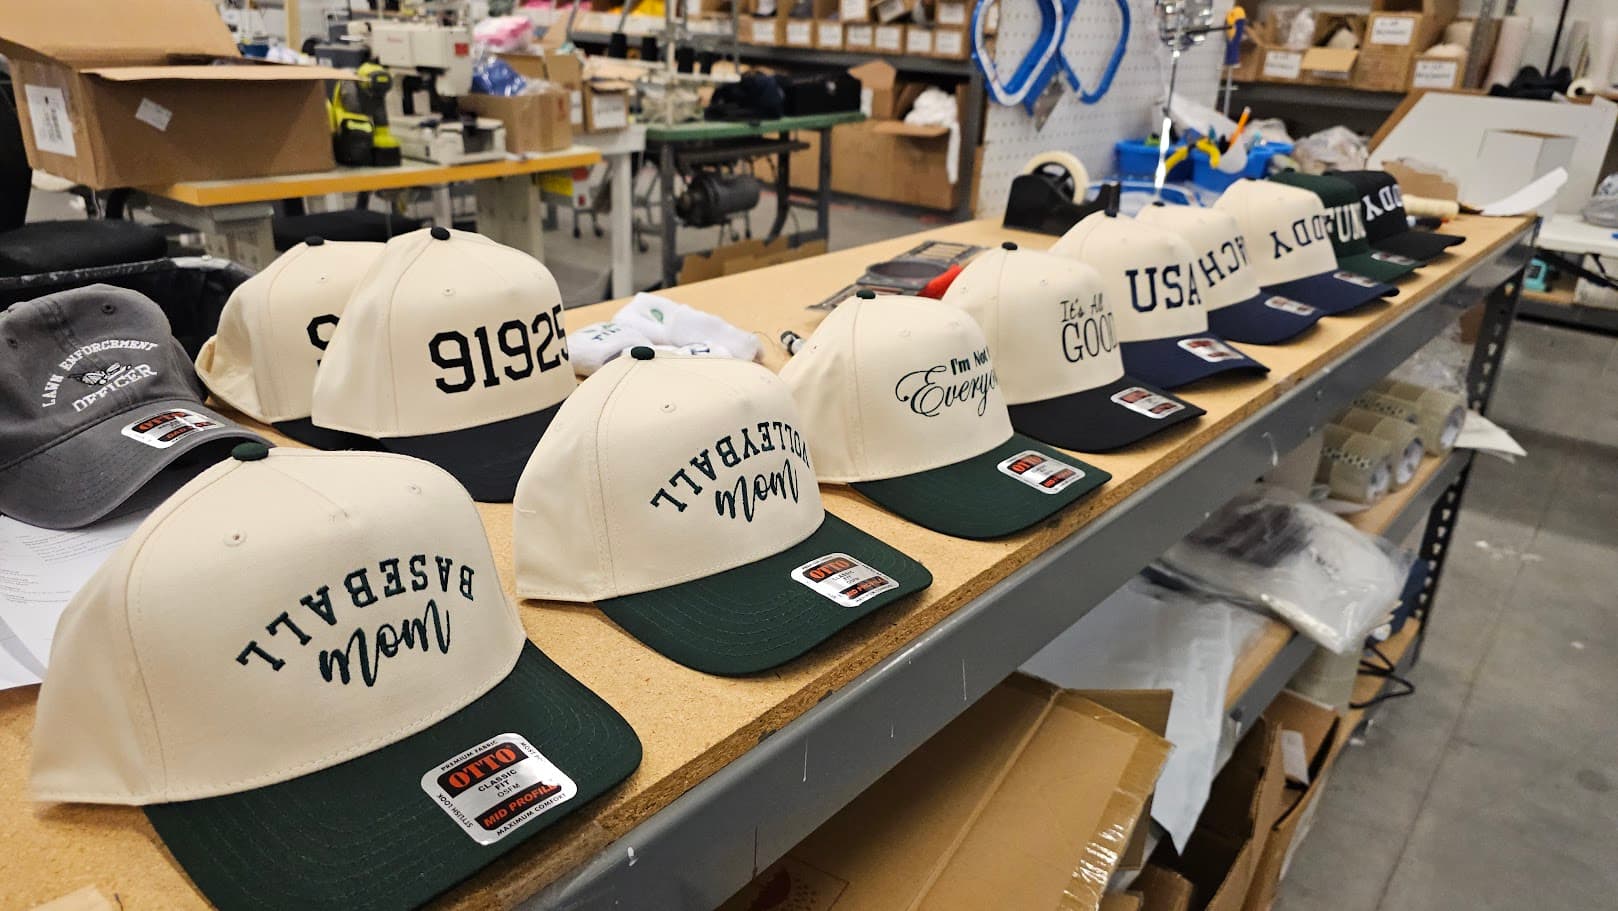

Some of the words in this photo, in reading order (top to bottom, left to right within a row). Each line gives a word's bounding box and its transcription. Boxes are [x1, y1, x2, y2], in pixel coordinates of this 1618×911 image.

[1125, 262, 1202, 313] USA
[428, 304, 569, 394] 91925
[42, 374, 64, 408] LAWN
[59, 339, 159, 372] ENFORCEMENT
[950, 358, 971, 375] I'm
[72, 363, 158, 412] OFFICER
[650, 421, 810, 513] VOLLEYBALL
[809, 559, 851, 579] OTTO
[235, 554, 475, 672] BASEBALL
[440, 751, 473, 771] PREMIUM
[448, 747, 517, 788] OTTO
[478, 769, 518, 792] CLASSIC
[494, 779, 511, 791] FIT
[497, 783, 521, 798] OSFM
[451, 806, 474, 829] STYLISH
[483, 807, 508, 828] MID
[497, 811, 534, 837] MAXIMUM
[534, 792, 567, 813] COMFORT
